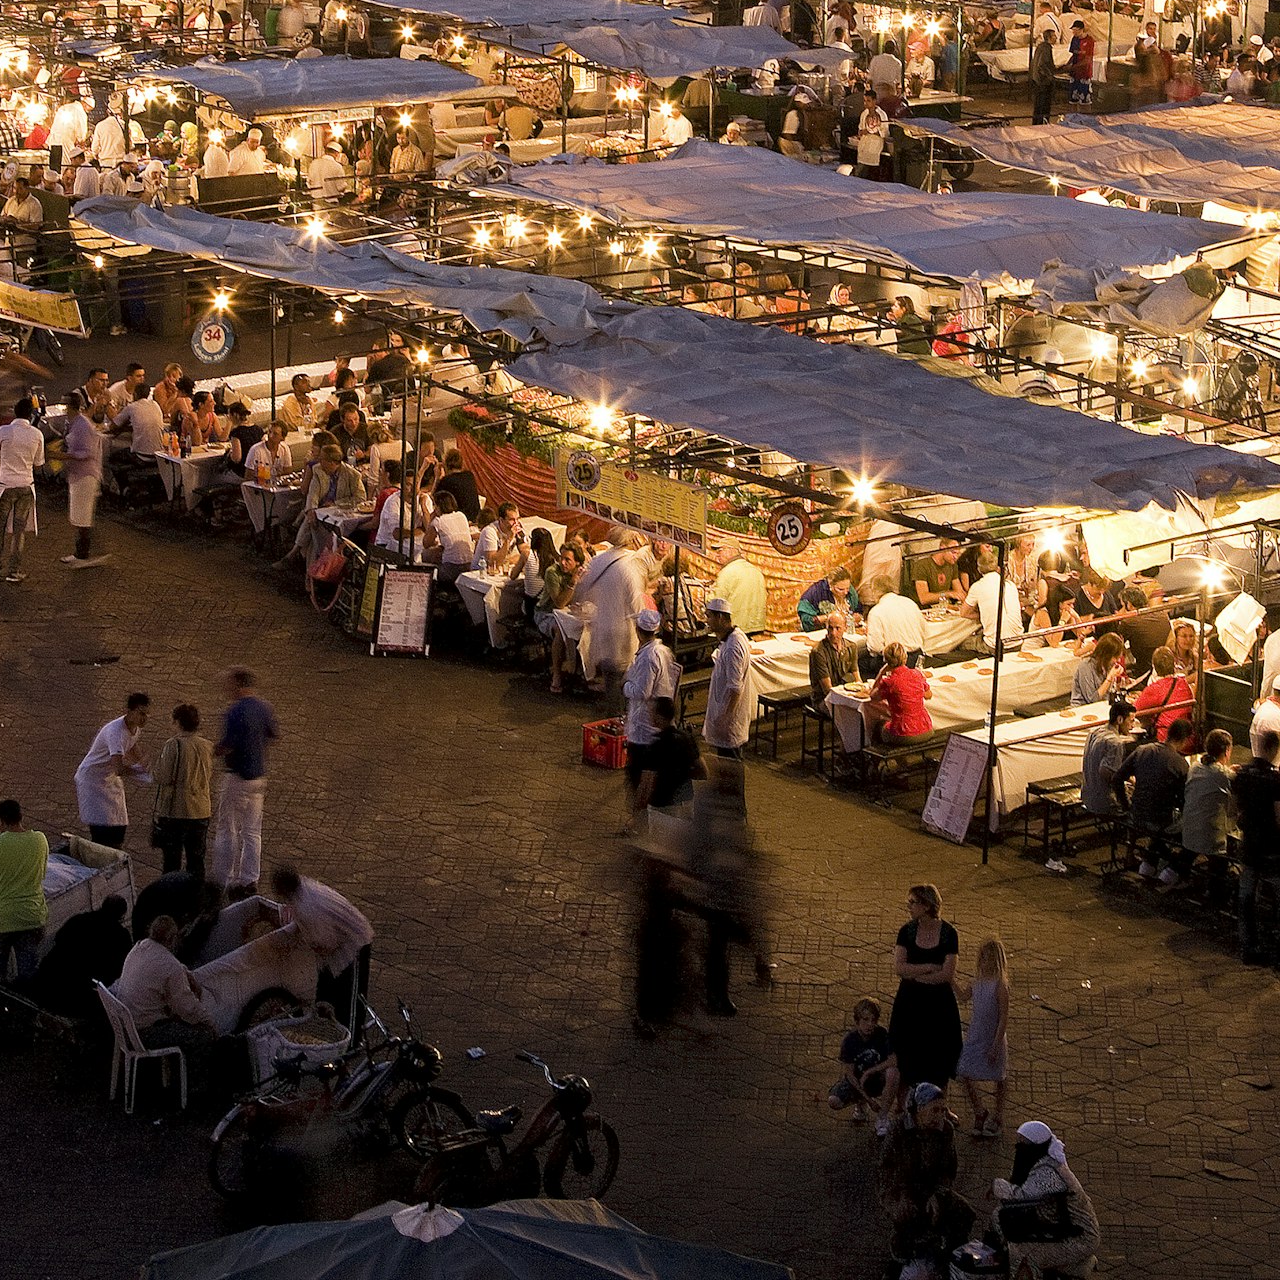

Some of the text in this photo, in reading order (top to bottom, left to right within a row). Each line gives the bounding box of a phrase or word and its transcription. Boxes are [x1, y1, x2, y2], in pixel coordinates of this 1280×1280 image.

[204, 328, 221, 341] 34
[575, 463, 592, 482] 25
[777, 517, 799, 541] 25
